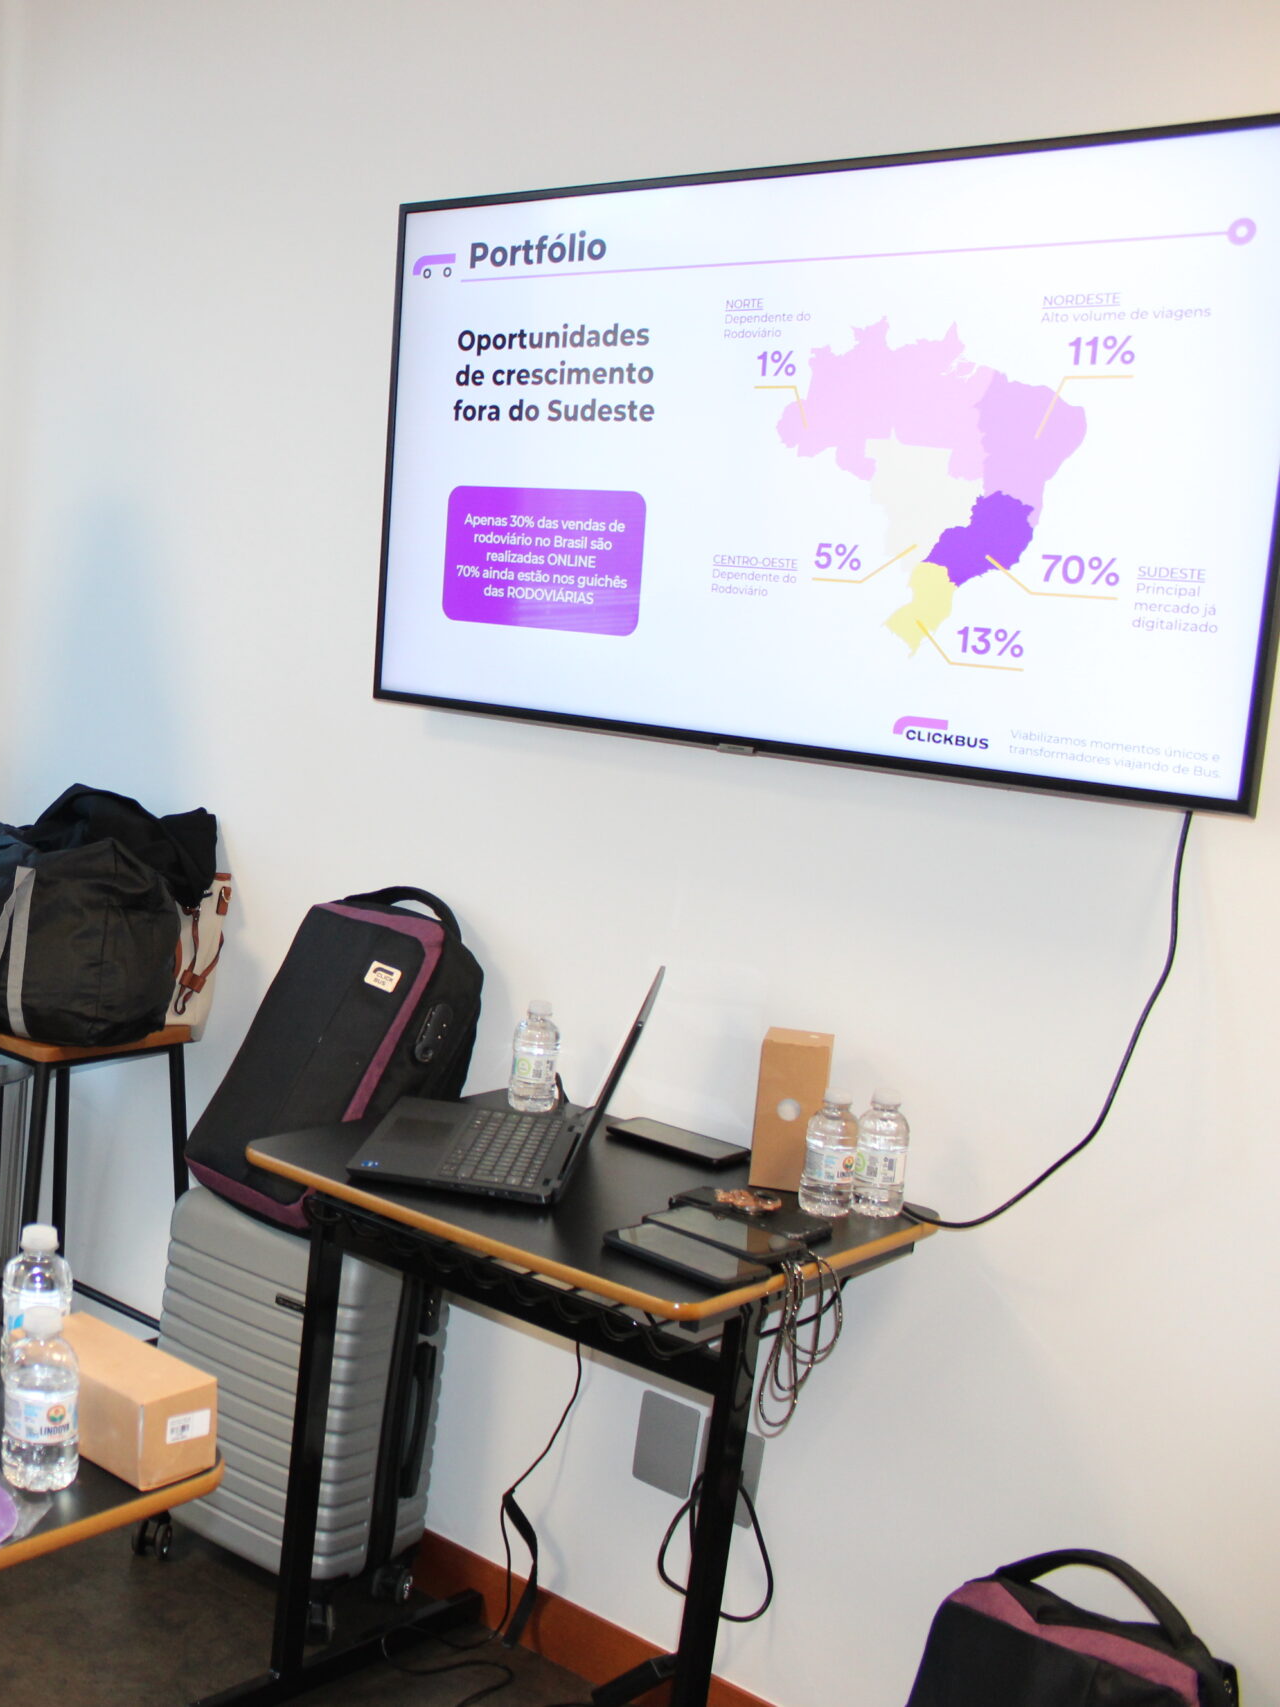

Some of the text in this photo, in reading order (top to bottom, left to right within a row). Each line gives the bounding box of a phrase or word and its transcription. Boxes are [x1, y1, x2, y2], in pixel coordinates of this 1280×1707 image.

[469, 230, 607, 269] Portfólio
[725, 298, 764, 309] NORTE
[1042, 292, 1121, 306] NORDESTE
[724, 312, 811, 325] Dependente do
[1041, 307, 1212, 323] Alto volume de viagens
[457, 323, 650, 356] Oportunidades
[724, 327, 782, 339] Rodoviário
[1068, 335, 1136, 365] 11%
[455, 360, 654, 387] de crescimento
[757, 350, 796, 377] 1%
[453, 398, 655, 422] fora do Sudeste
[464, 513, 626, 533] Apenas 30% das vendas de
[474, 532, 613, 551] rodoviário no Brasil são
[486, 550, 596, 568] realizadas ONLINE
[712, 554, 798, 569] CENTRO-OESTE
[814, 542, 861, 571] 5%
[456, 565, 628, 589] 70% ainda estão nos guichês
[712, 569, 797, 584] Dependente do
[1041, 554, 1120, 586] 70%
[1137, 566, 1206, 580] SUDESTE
[483, 584, 594, 604] das RODOVIÁRIAS
[711, 583, 768, 597] Rodoviário
[1136, 582, 1201, 599] Principal
[1134, 602, 1216, 618] mercado já
[1132, 616, 1218, 634] digitalizado
[956, 626, 1024, 658] 13%
[906, 729, 990, 750] CLICKBUS
[1010, 729, 1220, 762] Viabilizamos momentos únicos e
[1009, 744, 1111, 766] transformadores
[1114, 758, 1169, 772] viajando
[1172, 764, 1190, 775] de
